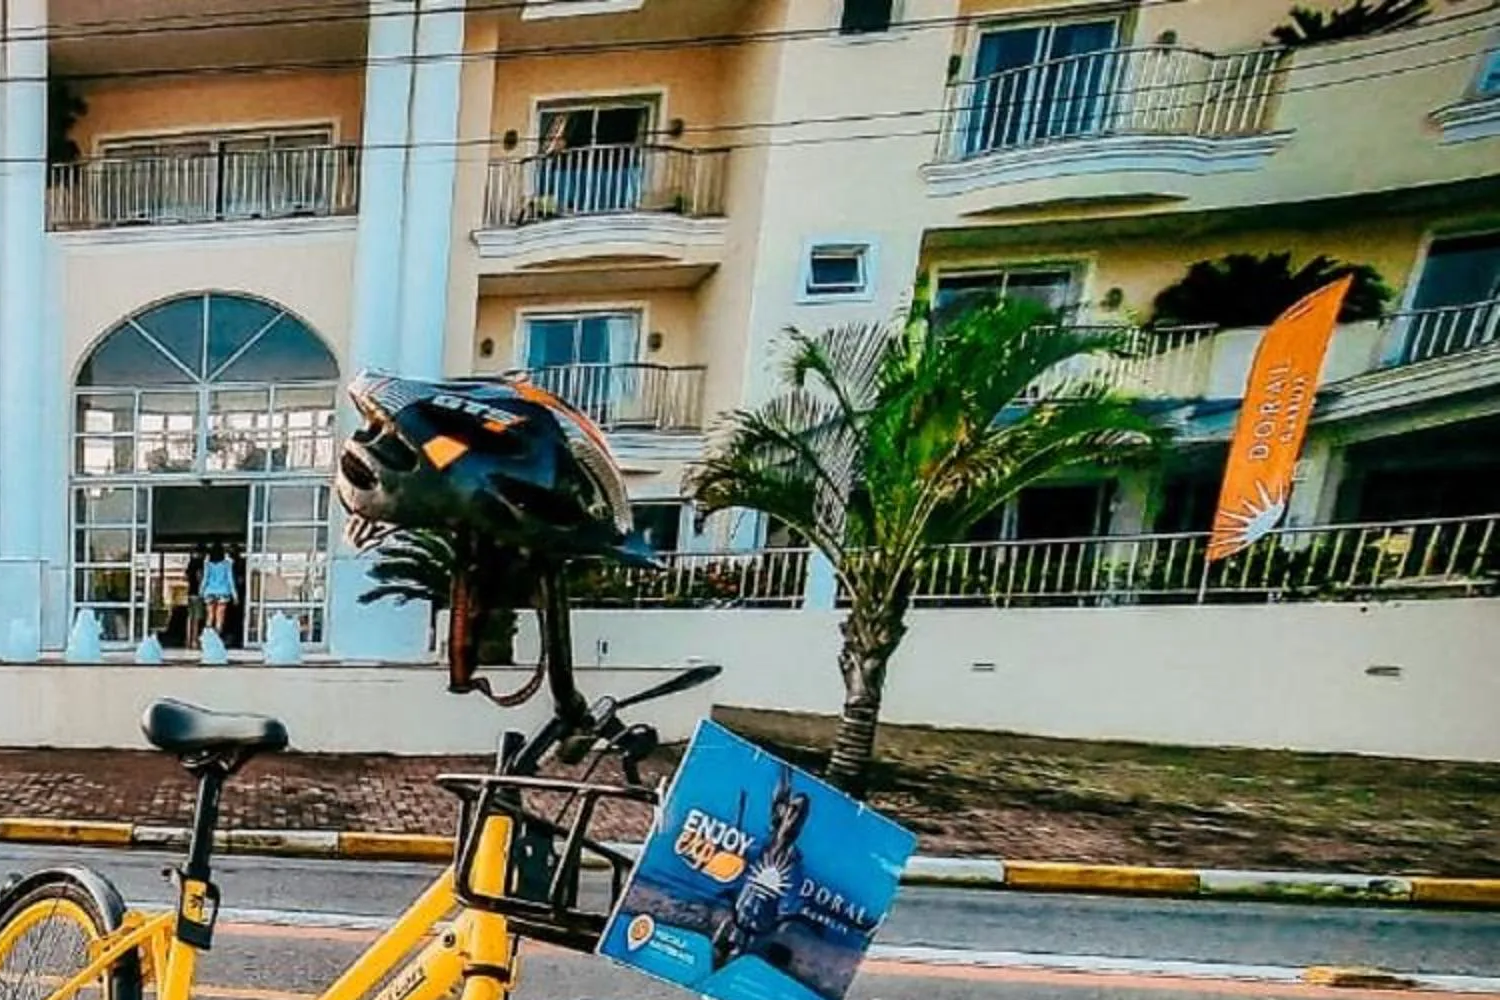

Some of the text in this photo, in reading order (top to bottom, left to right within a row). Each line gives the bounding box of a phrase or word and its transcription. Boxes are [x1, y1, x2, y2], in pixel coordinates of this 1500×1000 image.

[1249, 368, 1288, 459] DORAL
[684, 809, 756, 857] ENJOY
[800, 878, 866, 926] DORAL
